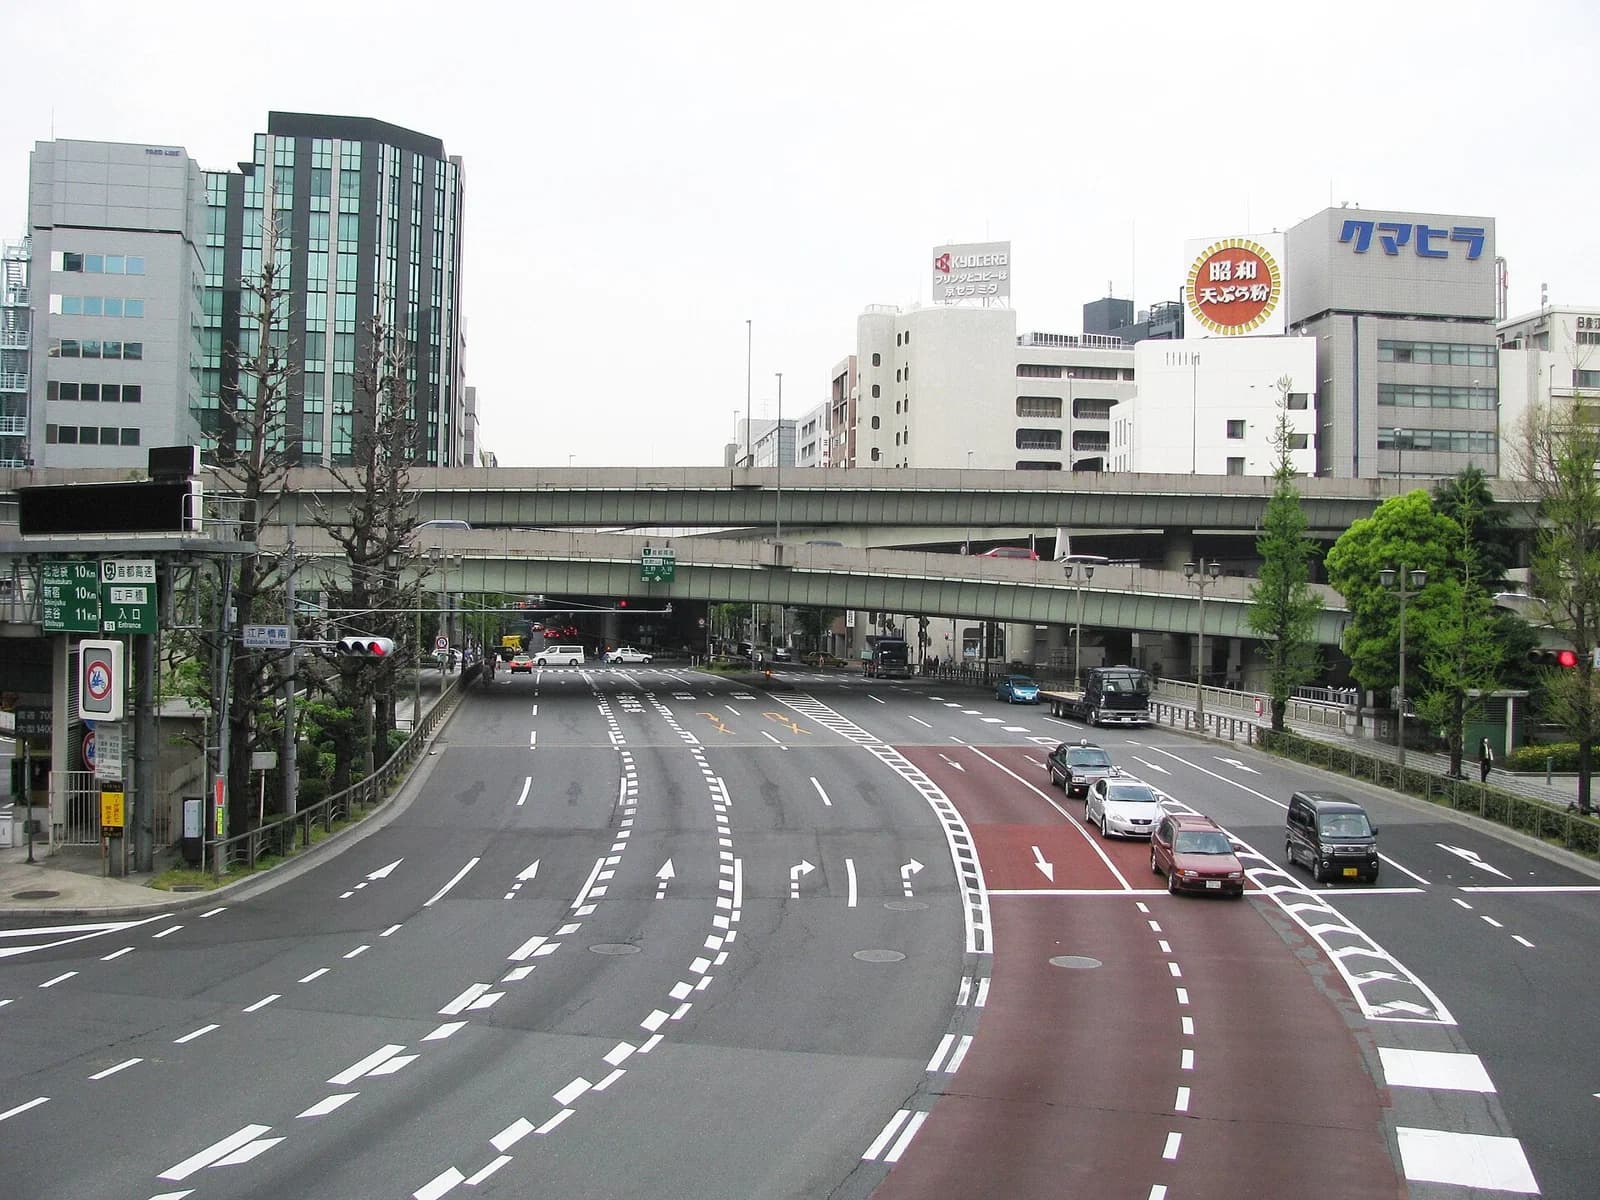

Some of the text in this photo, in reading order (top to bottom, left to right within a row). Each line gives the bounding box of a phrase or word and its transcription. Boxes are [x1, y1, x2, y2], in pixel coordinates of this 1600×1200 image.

[1338, 219, 1485, 260] クマヒラ
[951, 254, 1008, 268] KYOCERA
[1209, 260, 1257, 282] 昭和
[935, 272, 1008, 285] プリンタとコピーは
[1199, 284, 1269, 305] 天ぷら粉
[118, 566, 152, 577] 首都高速
[43, 586, 60, 599] 新宿
[114, 589, 144, 602] 江戸橋
[44, 607, 61, 619] 渋谷
[118, 607, 140, 620] 入口
[118, 621, 141, 629] Entrance
[248, 628, 287, 639] 江戸橋南
